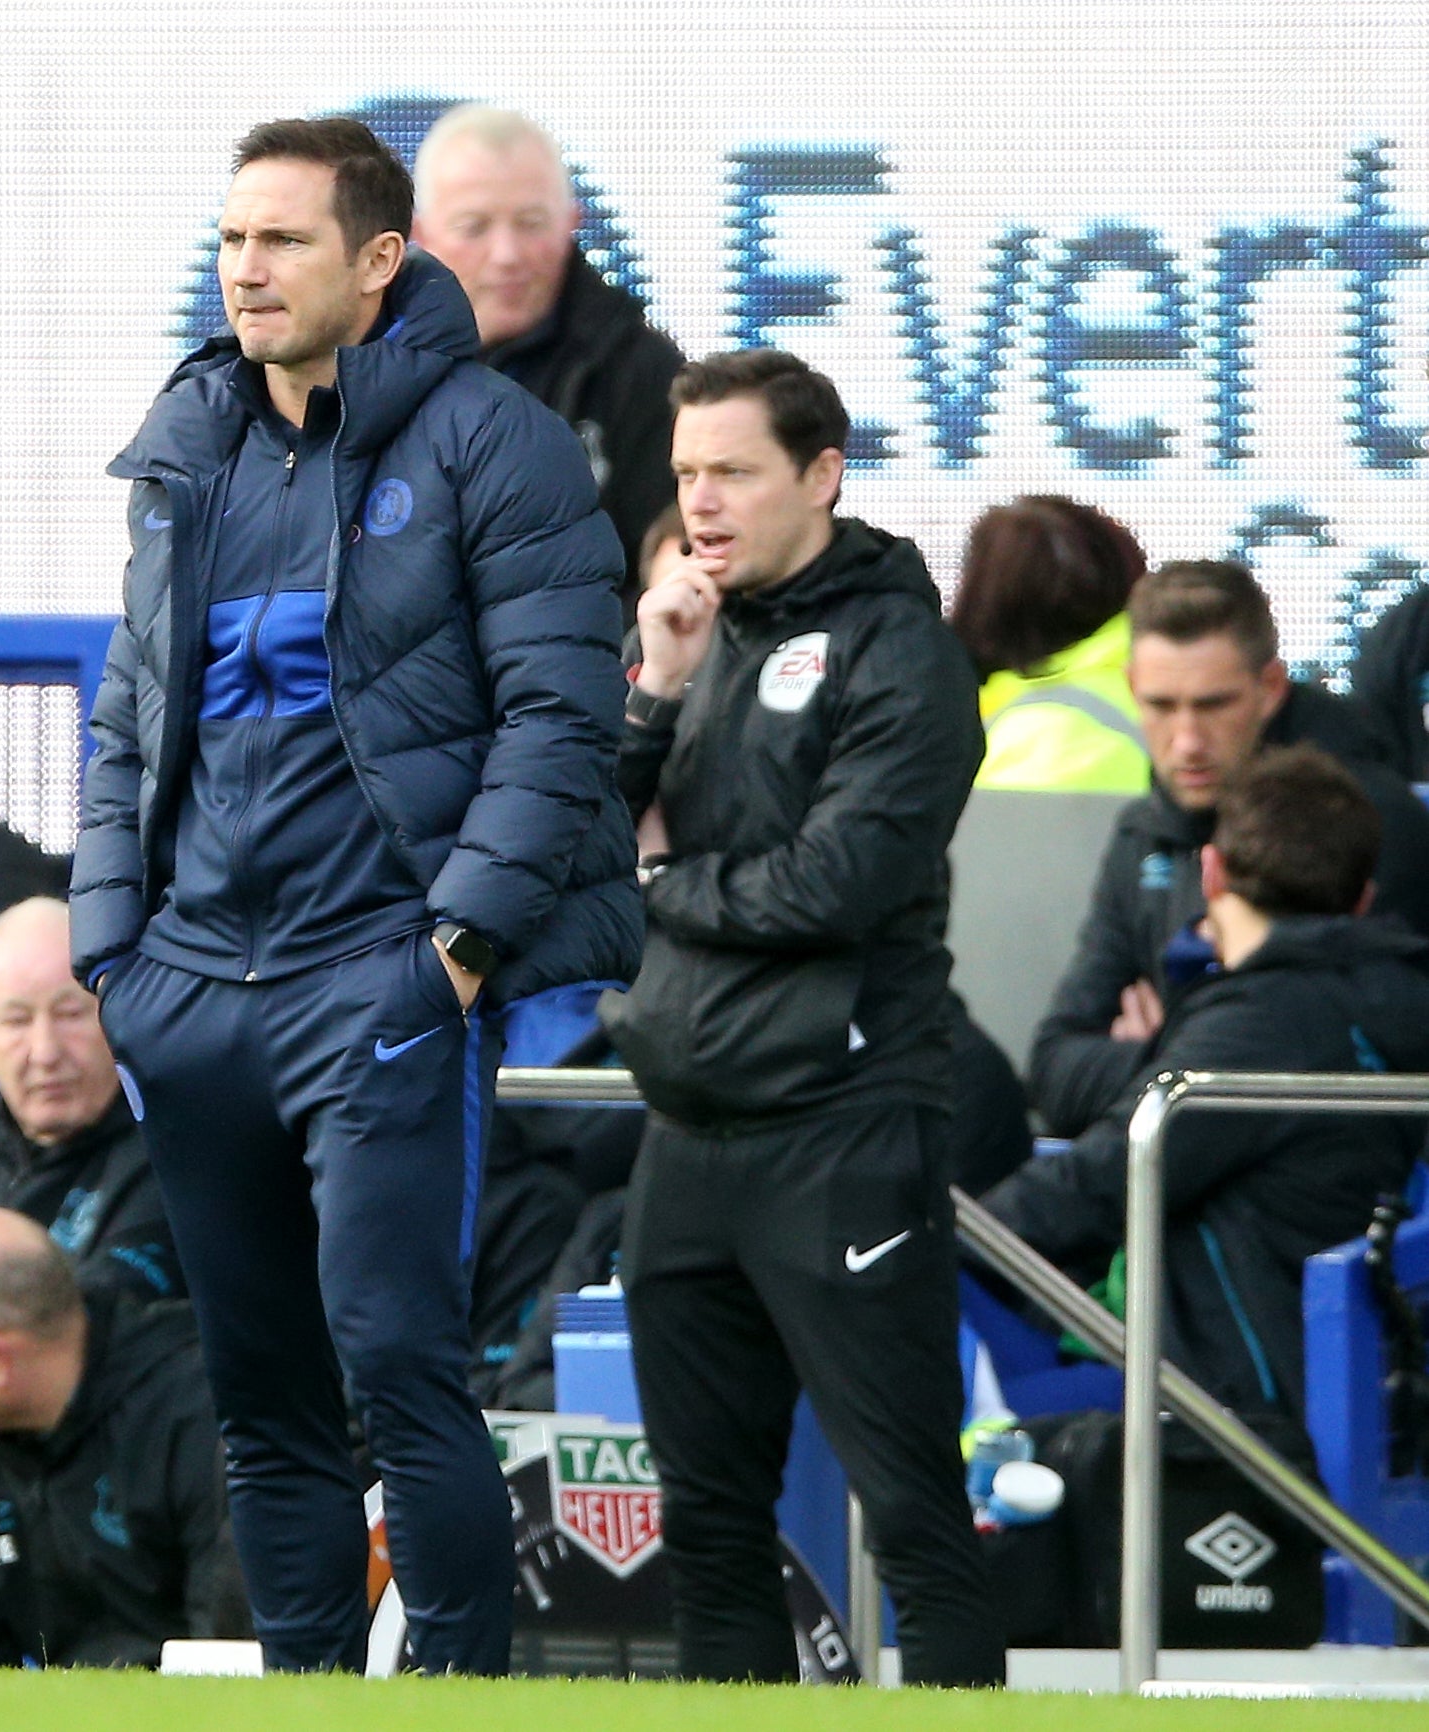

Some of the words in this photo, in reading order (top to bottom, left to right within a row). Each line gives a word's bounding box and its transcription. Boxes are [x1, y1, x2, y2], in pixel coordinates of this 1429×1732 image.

[775, 650, 826, 675] EA
[560, 1438, 660, 1483] TAG
[1195, 1581, 1274, 1612] umbro
[810, 1614, 849, 1671] 10
